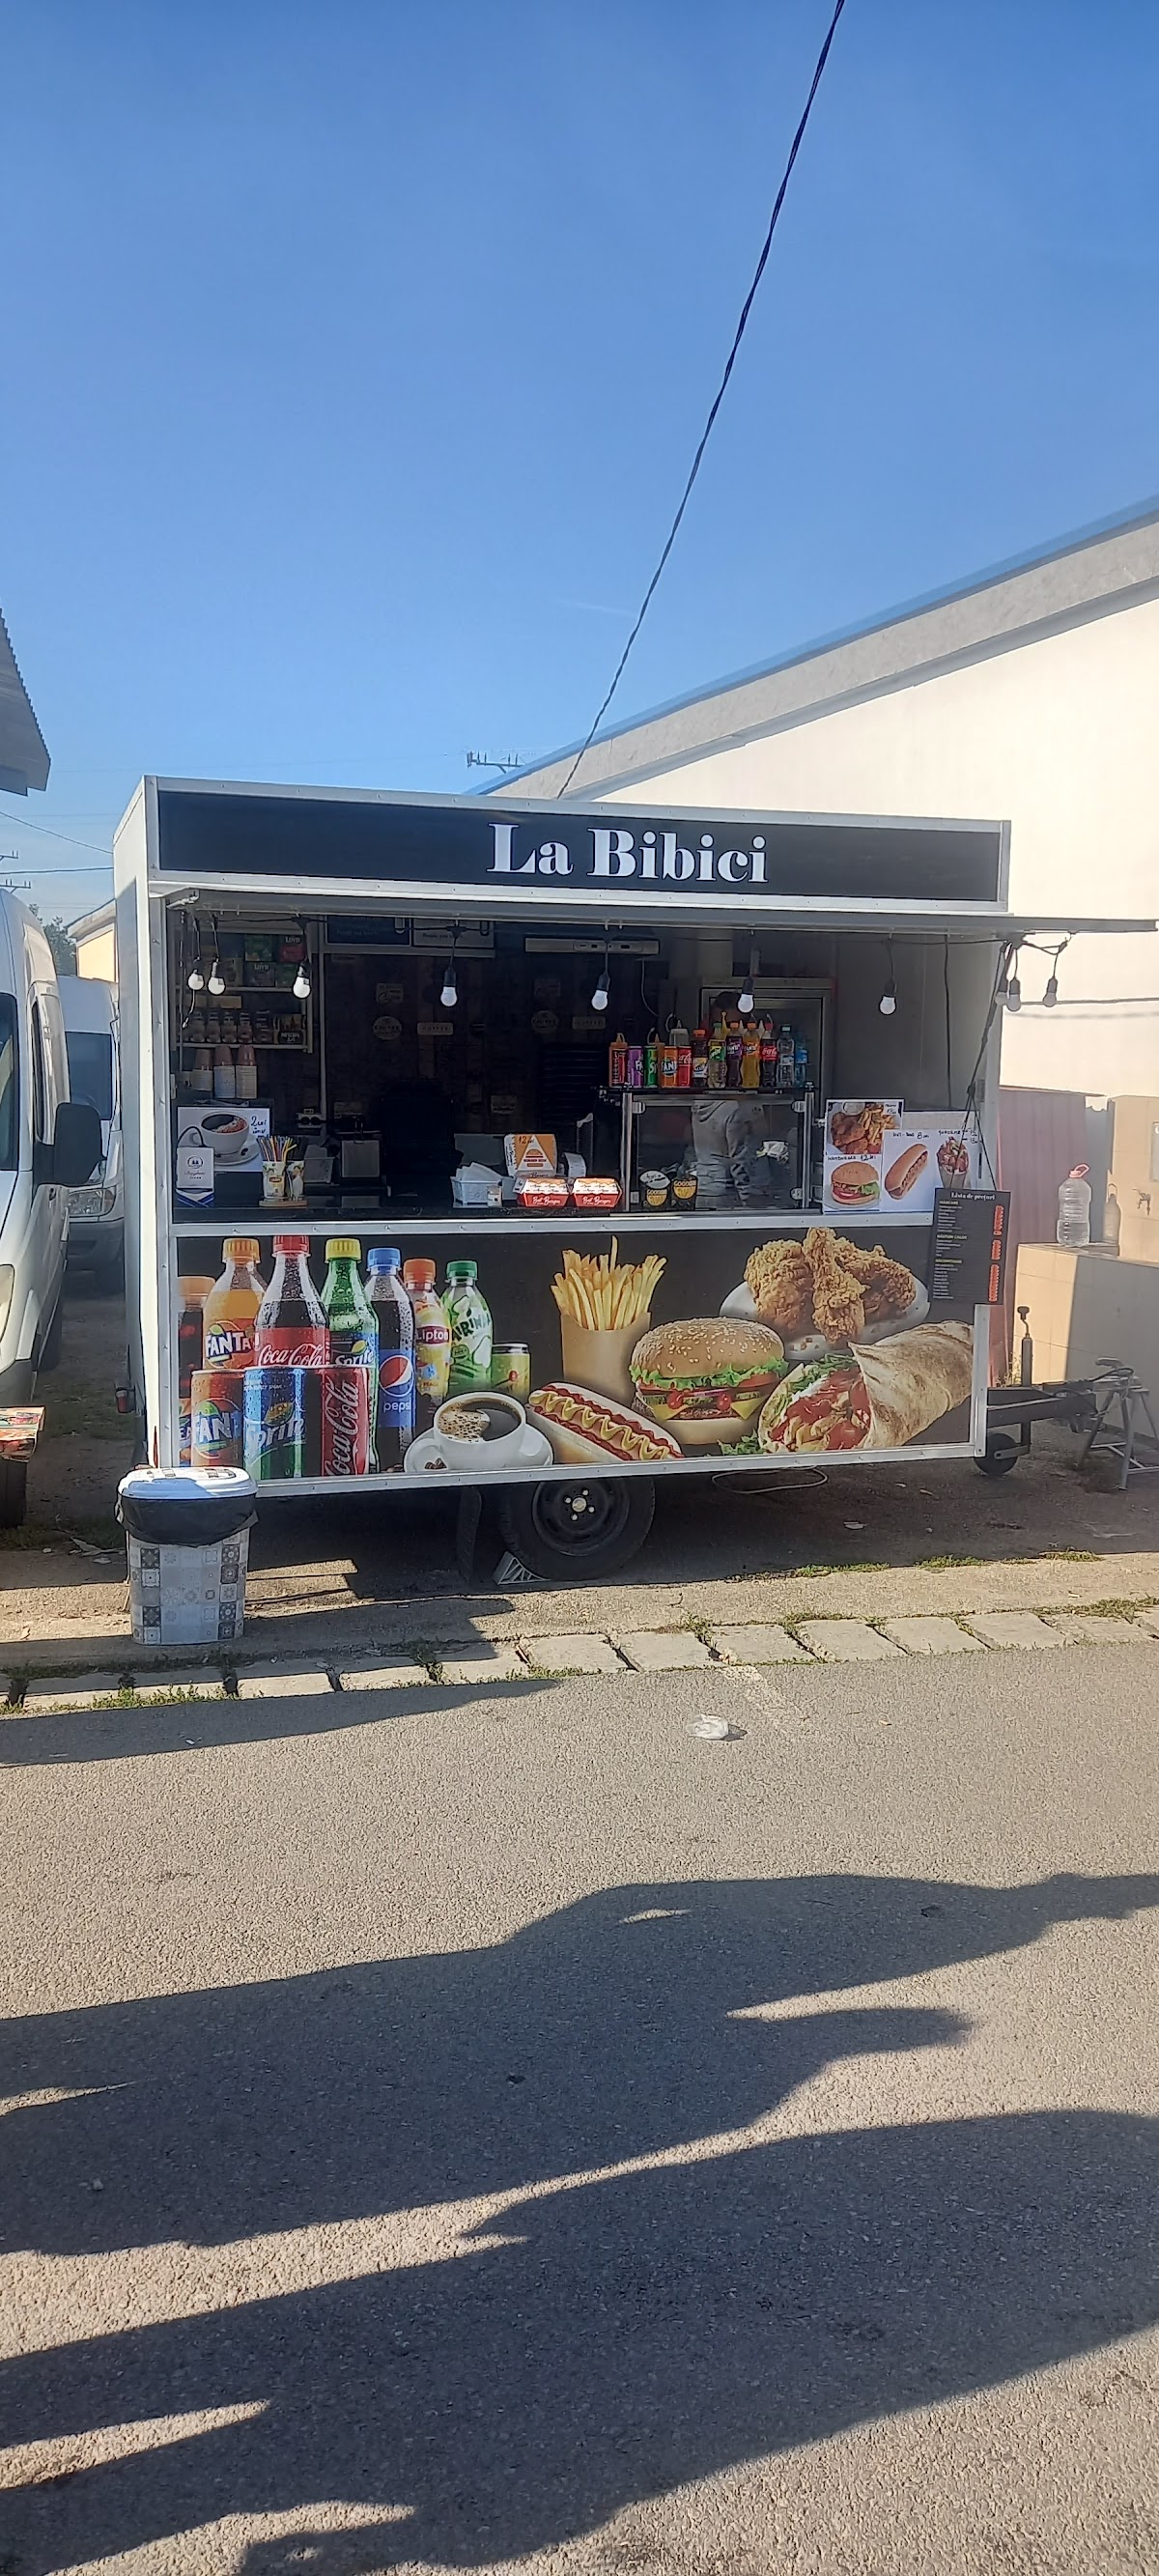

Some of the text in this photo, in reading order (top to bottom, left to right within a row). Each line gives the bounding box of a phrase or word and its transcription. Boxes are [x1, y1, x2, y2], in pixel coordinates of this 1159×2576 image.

[487, 824, 768, 883] La Bibici
[206, 1332, 252, 1357] FANTA
[416, 1330, 449, 1342] Lipton
[258, 1344, 324, 1367] Coca-Cola
[335, 1349, 374, 1365] Sprite
[192, 1411, 242, 1443] FANT
[245, 1415, 306, 1449] Sprite
[325, 1376, 359, 1476] Coca-Cola
